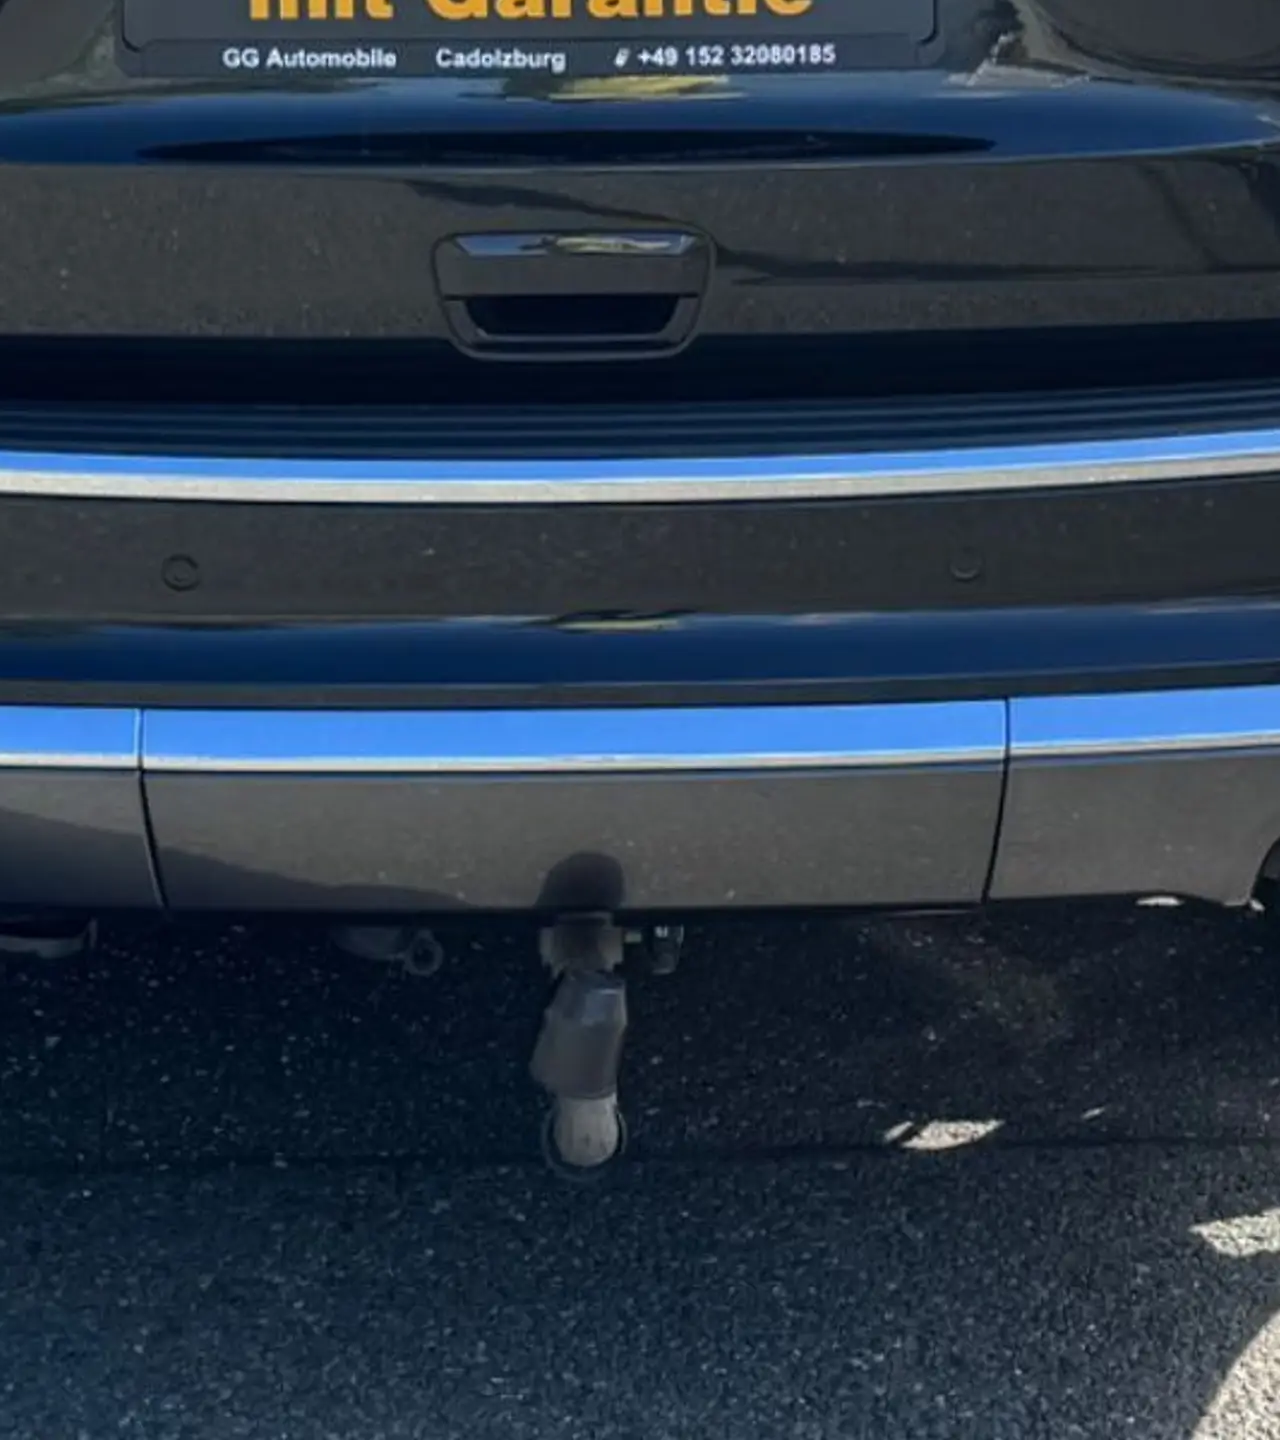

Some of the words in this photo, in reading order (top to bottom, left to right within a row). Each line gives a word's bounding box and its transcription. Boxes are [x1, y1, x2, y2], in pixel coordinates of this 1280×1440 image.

[222, 47, 260, 69] GG
[266, 47, 398, 69] Automobile
[435, 47, 567, 74] Cadolzburg
[637, 46, 679, 68] +49
[685, 45, 725, 67] 152
